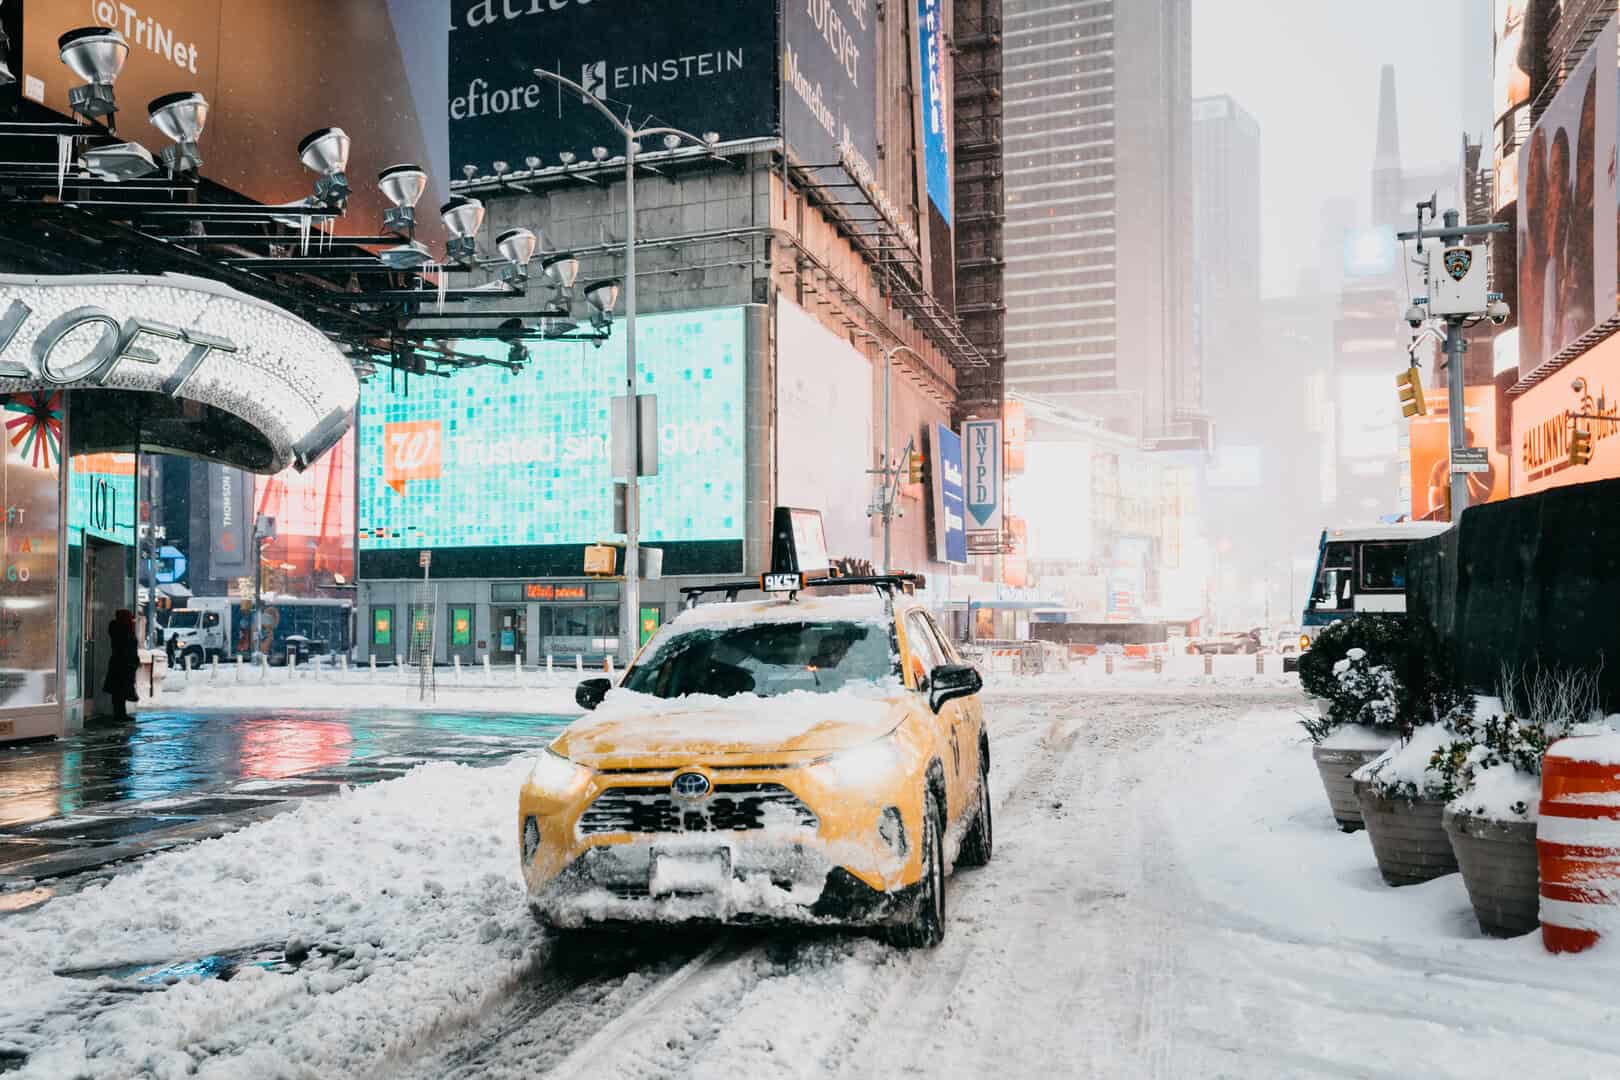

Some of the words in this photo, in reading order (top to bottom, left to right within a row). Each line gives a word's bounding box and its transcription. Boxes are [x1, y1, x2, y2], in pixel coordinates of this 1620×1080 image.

[92, 0, 198, 75] @TriNet
[614, 47, 744, 89] EINSTEIN
[807, 0, 860, 88] orever
[0, 299, 237, 398] LOFT
[222, 475, 233, 528] THOMSON
[976, 427, 987, 503] NYPD
